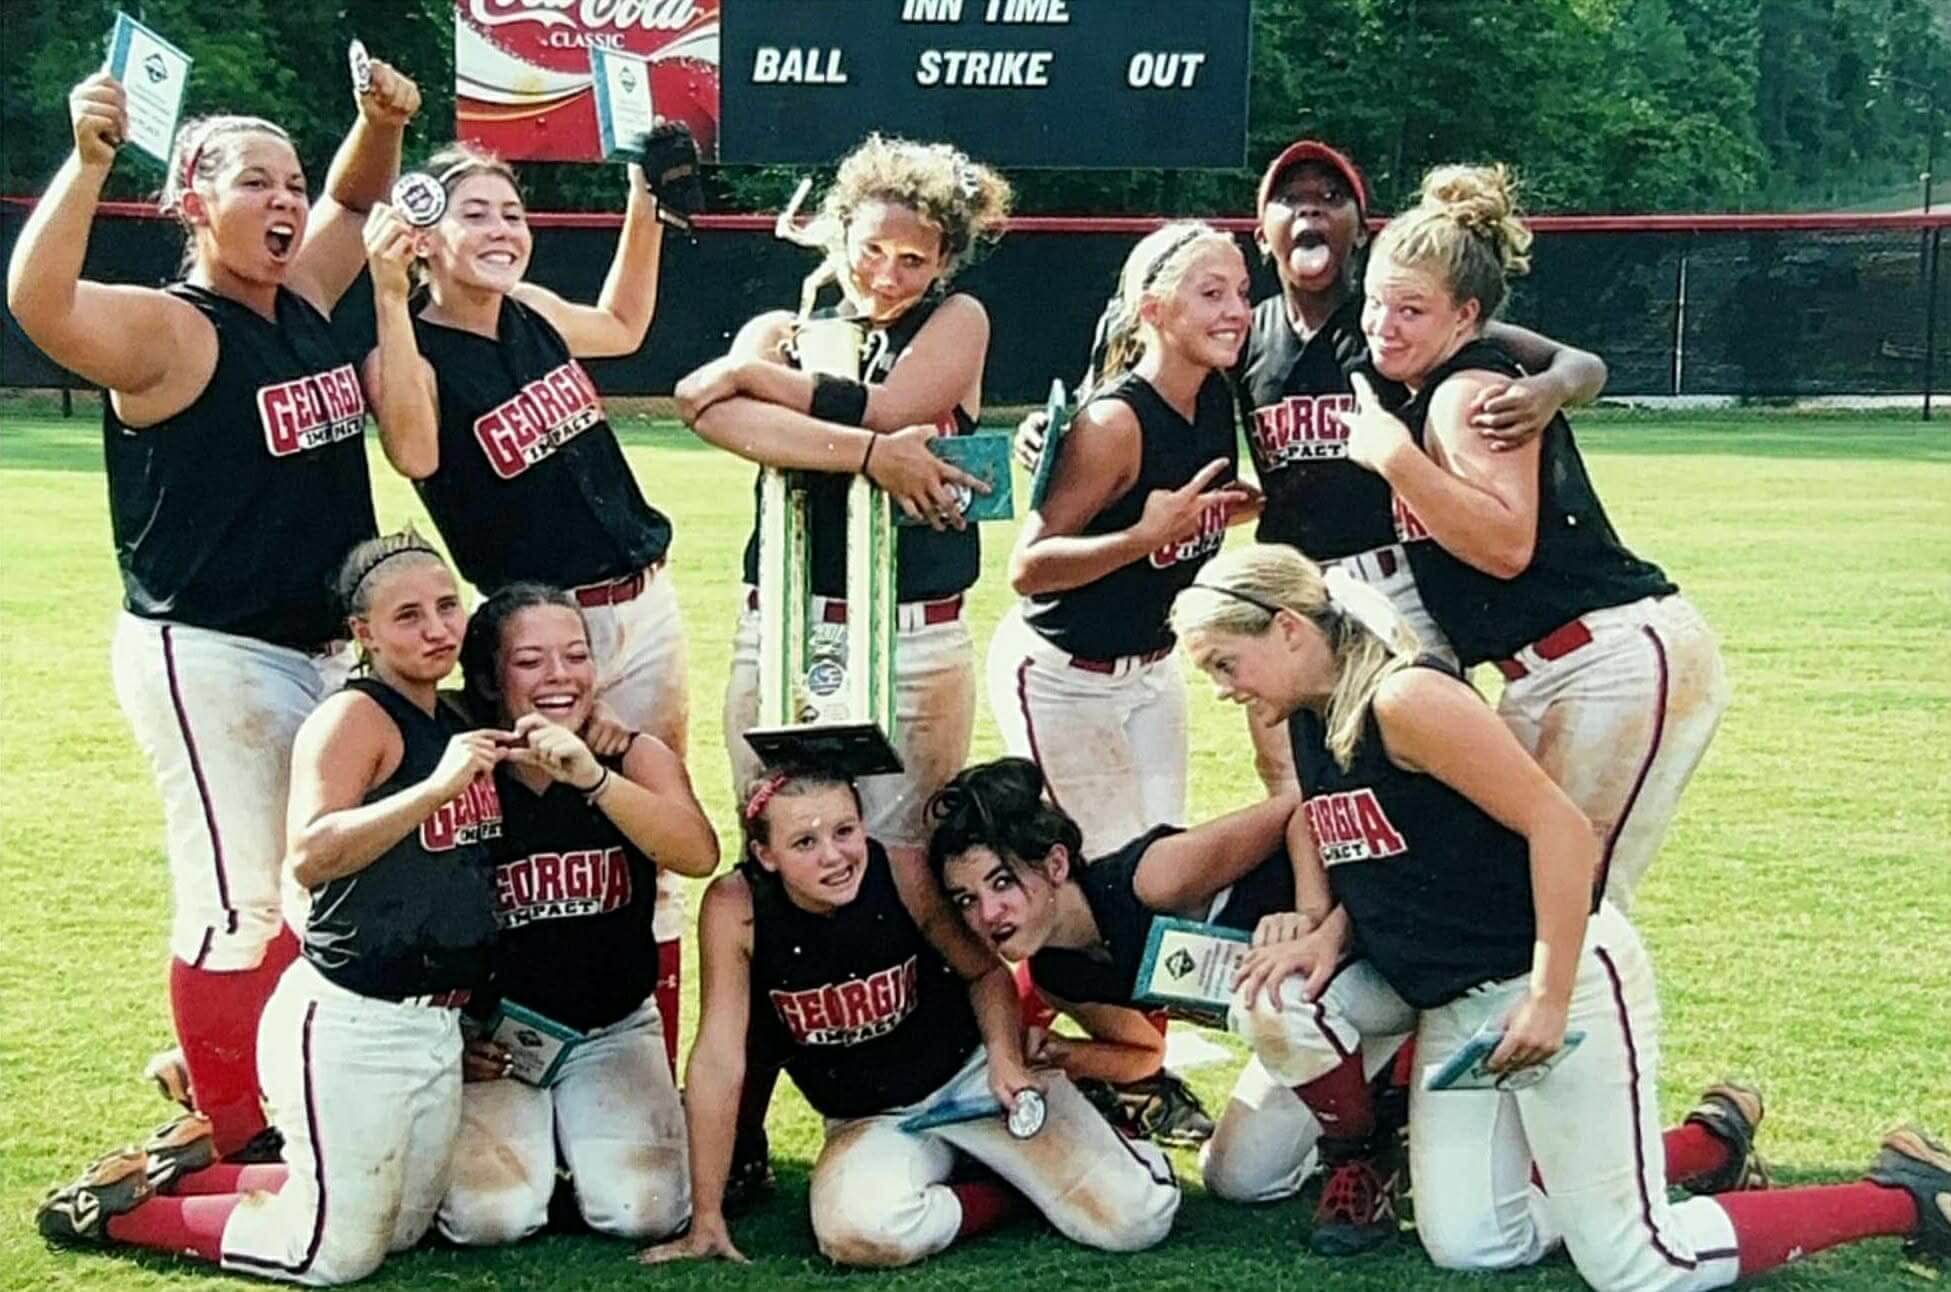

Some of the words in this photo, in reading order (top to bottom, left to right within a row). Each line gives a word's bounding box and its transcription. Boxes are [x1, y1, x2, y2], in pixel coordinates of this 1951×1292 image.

[902, 0, 963, 22] INN
[550, 31, 625, 48] CLASSIC
[752, 48, 847, 83] BALL
[917, 50, 1053, 86] STRIKE
[1128, 52, 1205, 88] OUT
[495, 846, 632, 914] EORGIA
